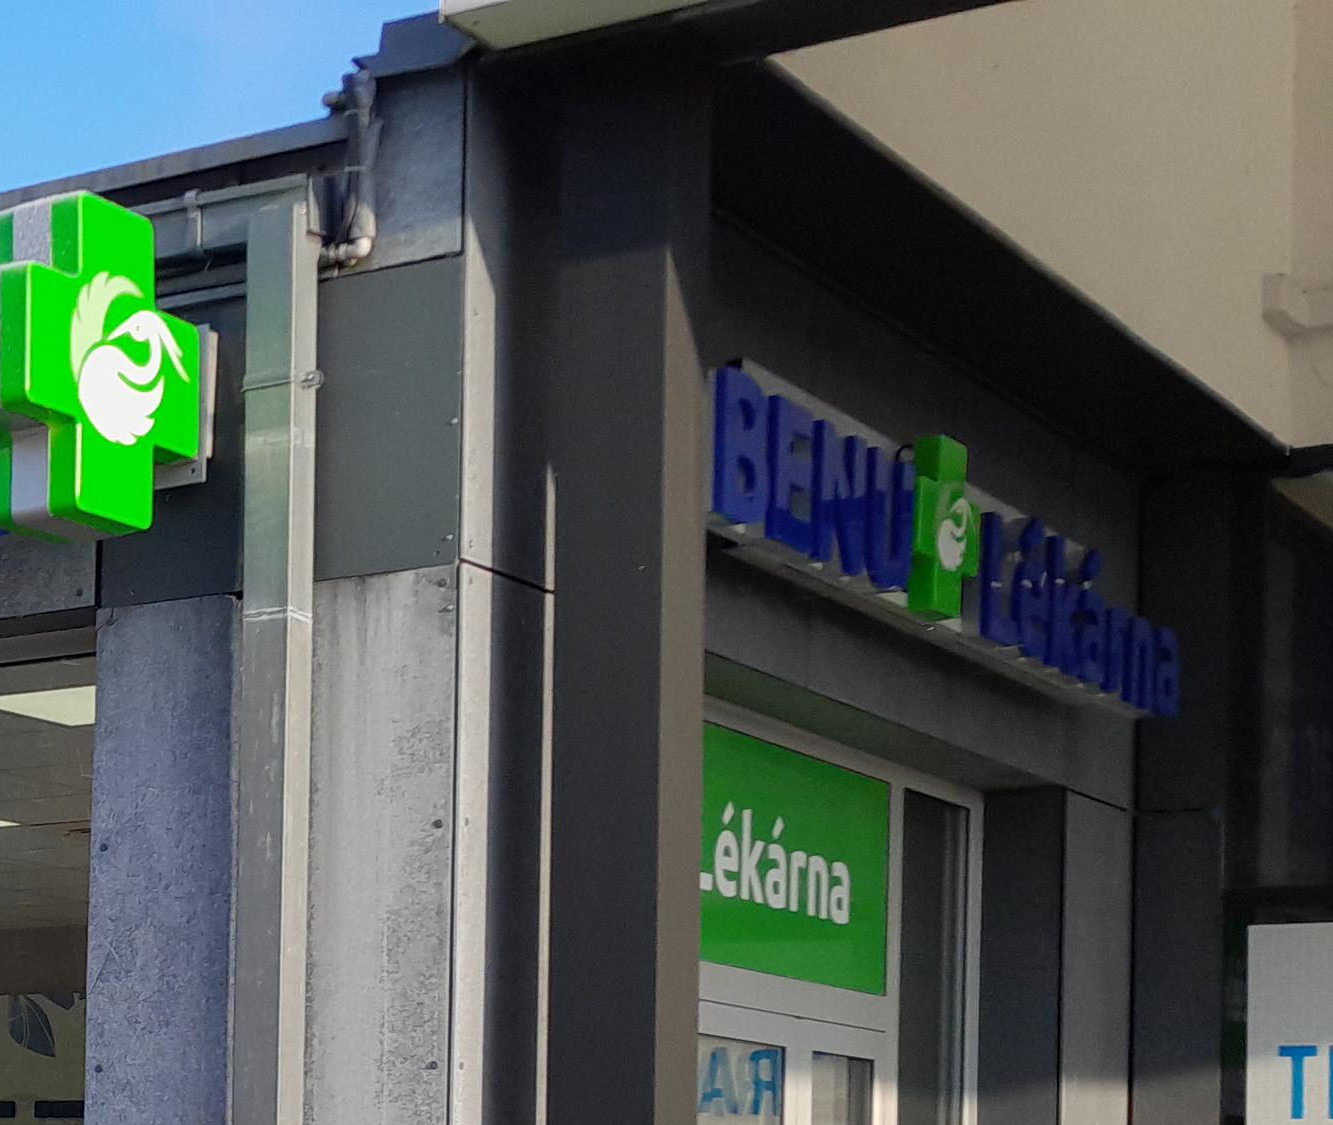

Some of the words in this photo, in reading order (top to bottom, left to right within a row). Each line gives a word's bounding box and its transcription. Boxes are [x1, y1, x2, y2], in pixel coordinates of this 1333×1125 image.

[712, 366, 917, 590] BENU
[979, 512, 1180, 717] Lékárna
[699, 801, 851, 924] ékárna
[1278, 1045, 1333, 1119] T
